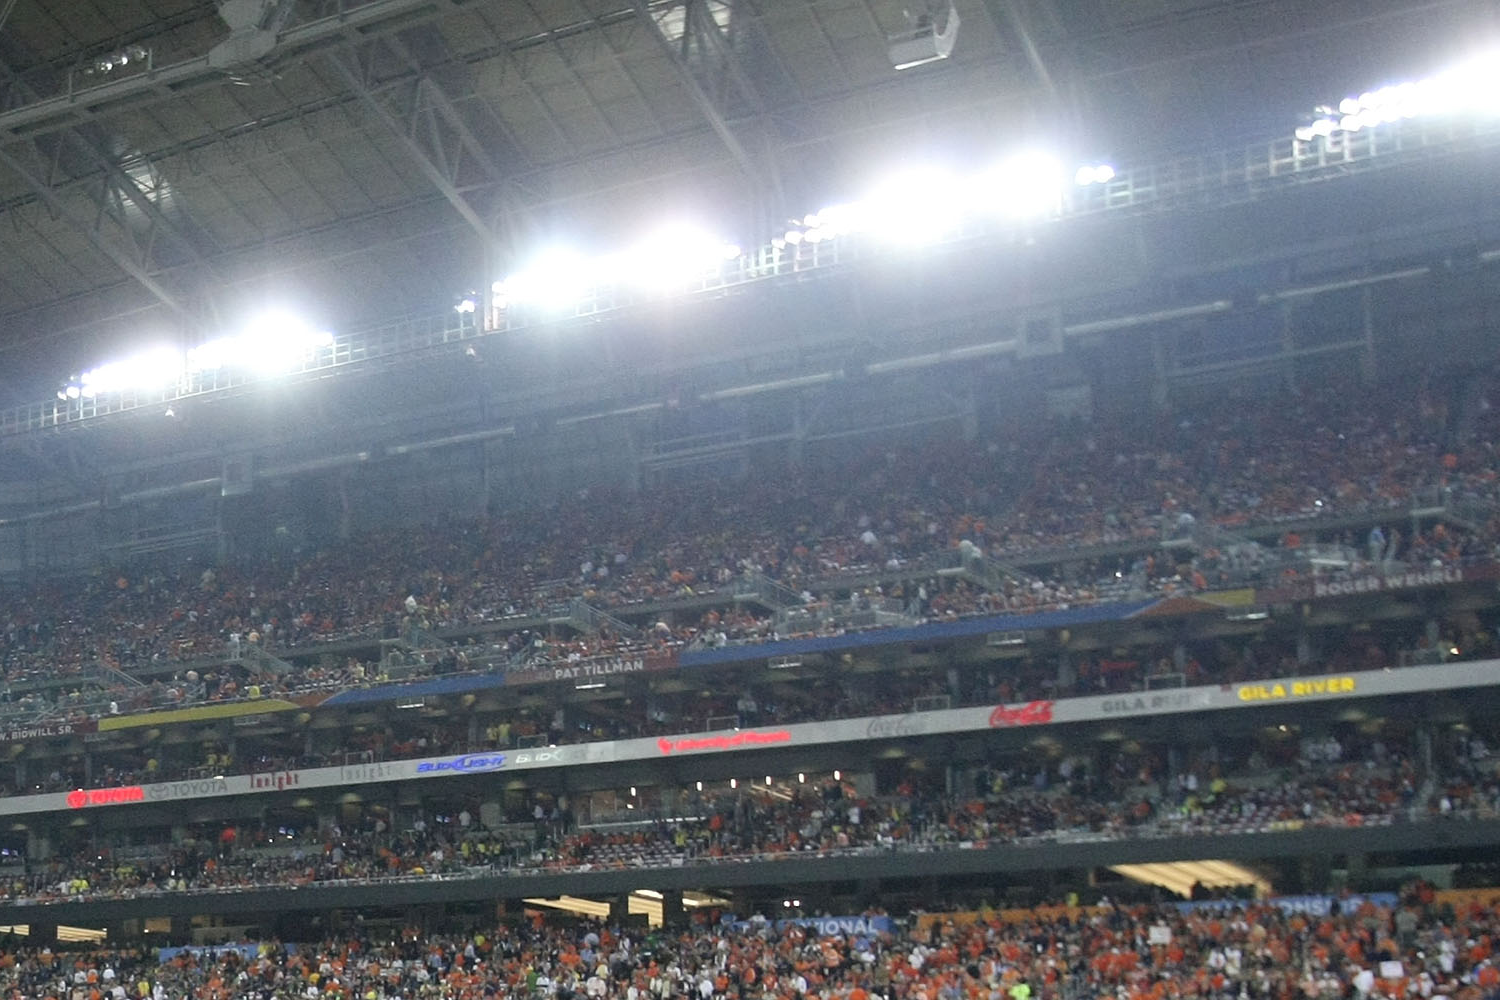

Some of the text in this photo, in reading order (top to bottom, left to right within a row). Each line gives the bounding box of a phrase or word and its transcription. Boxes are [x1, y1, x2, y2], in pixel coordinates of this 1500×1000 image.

[1315, 577, 1380, 597] ROGER
[555, 667, 580, 680] PAT
[584, 660, 644, 676] TILLMAN
[1238, 677, 1355, 701] GILA RIVER
[58, 725, 75, 735] SR.
[171, 780, 228, 797] TOYOTA
